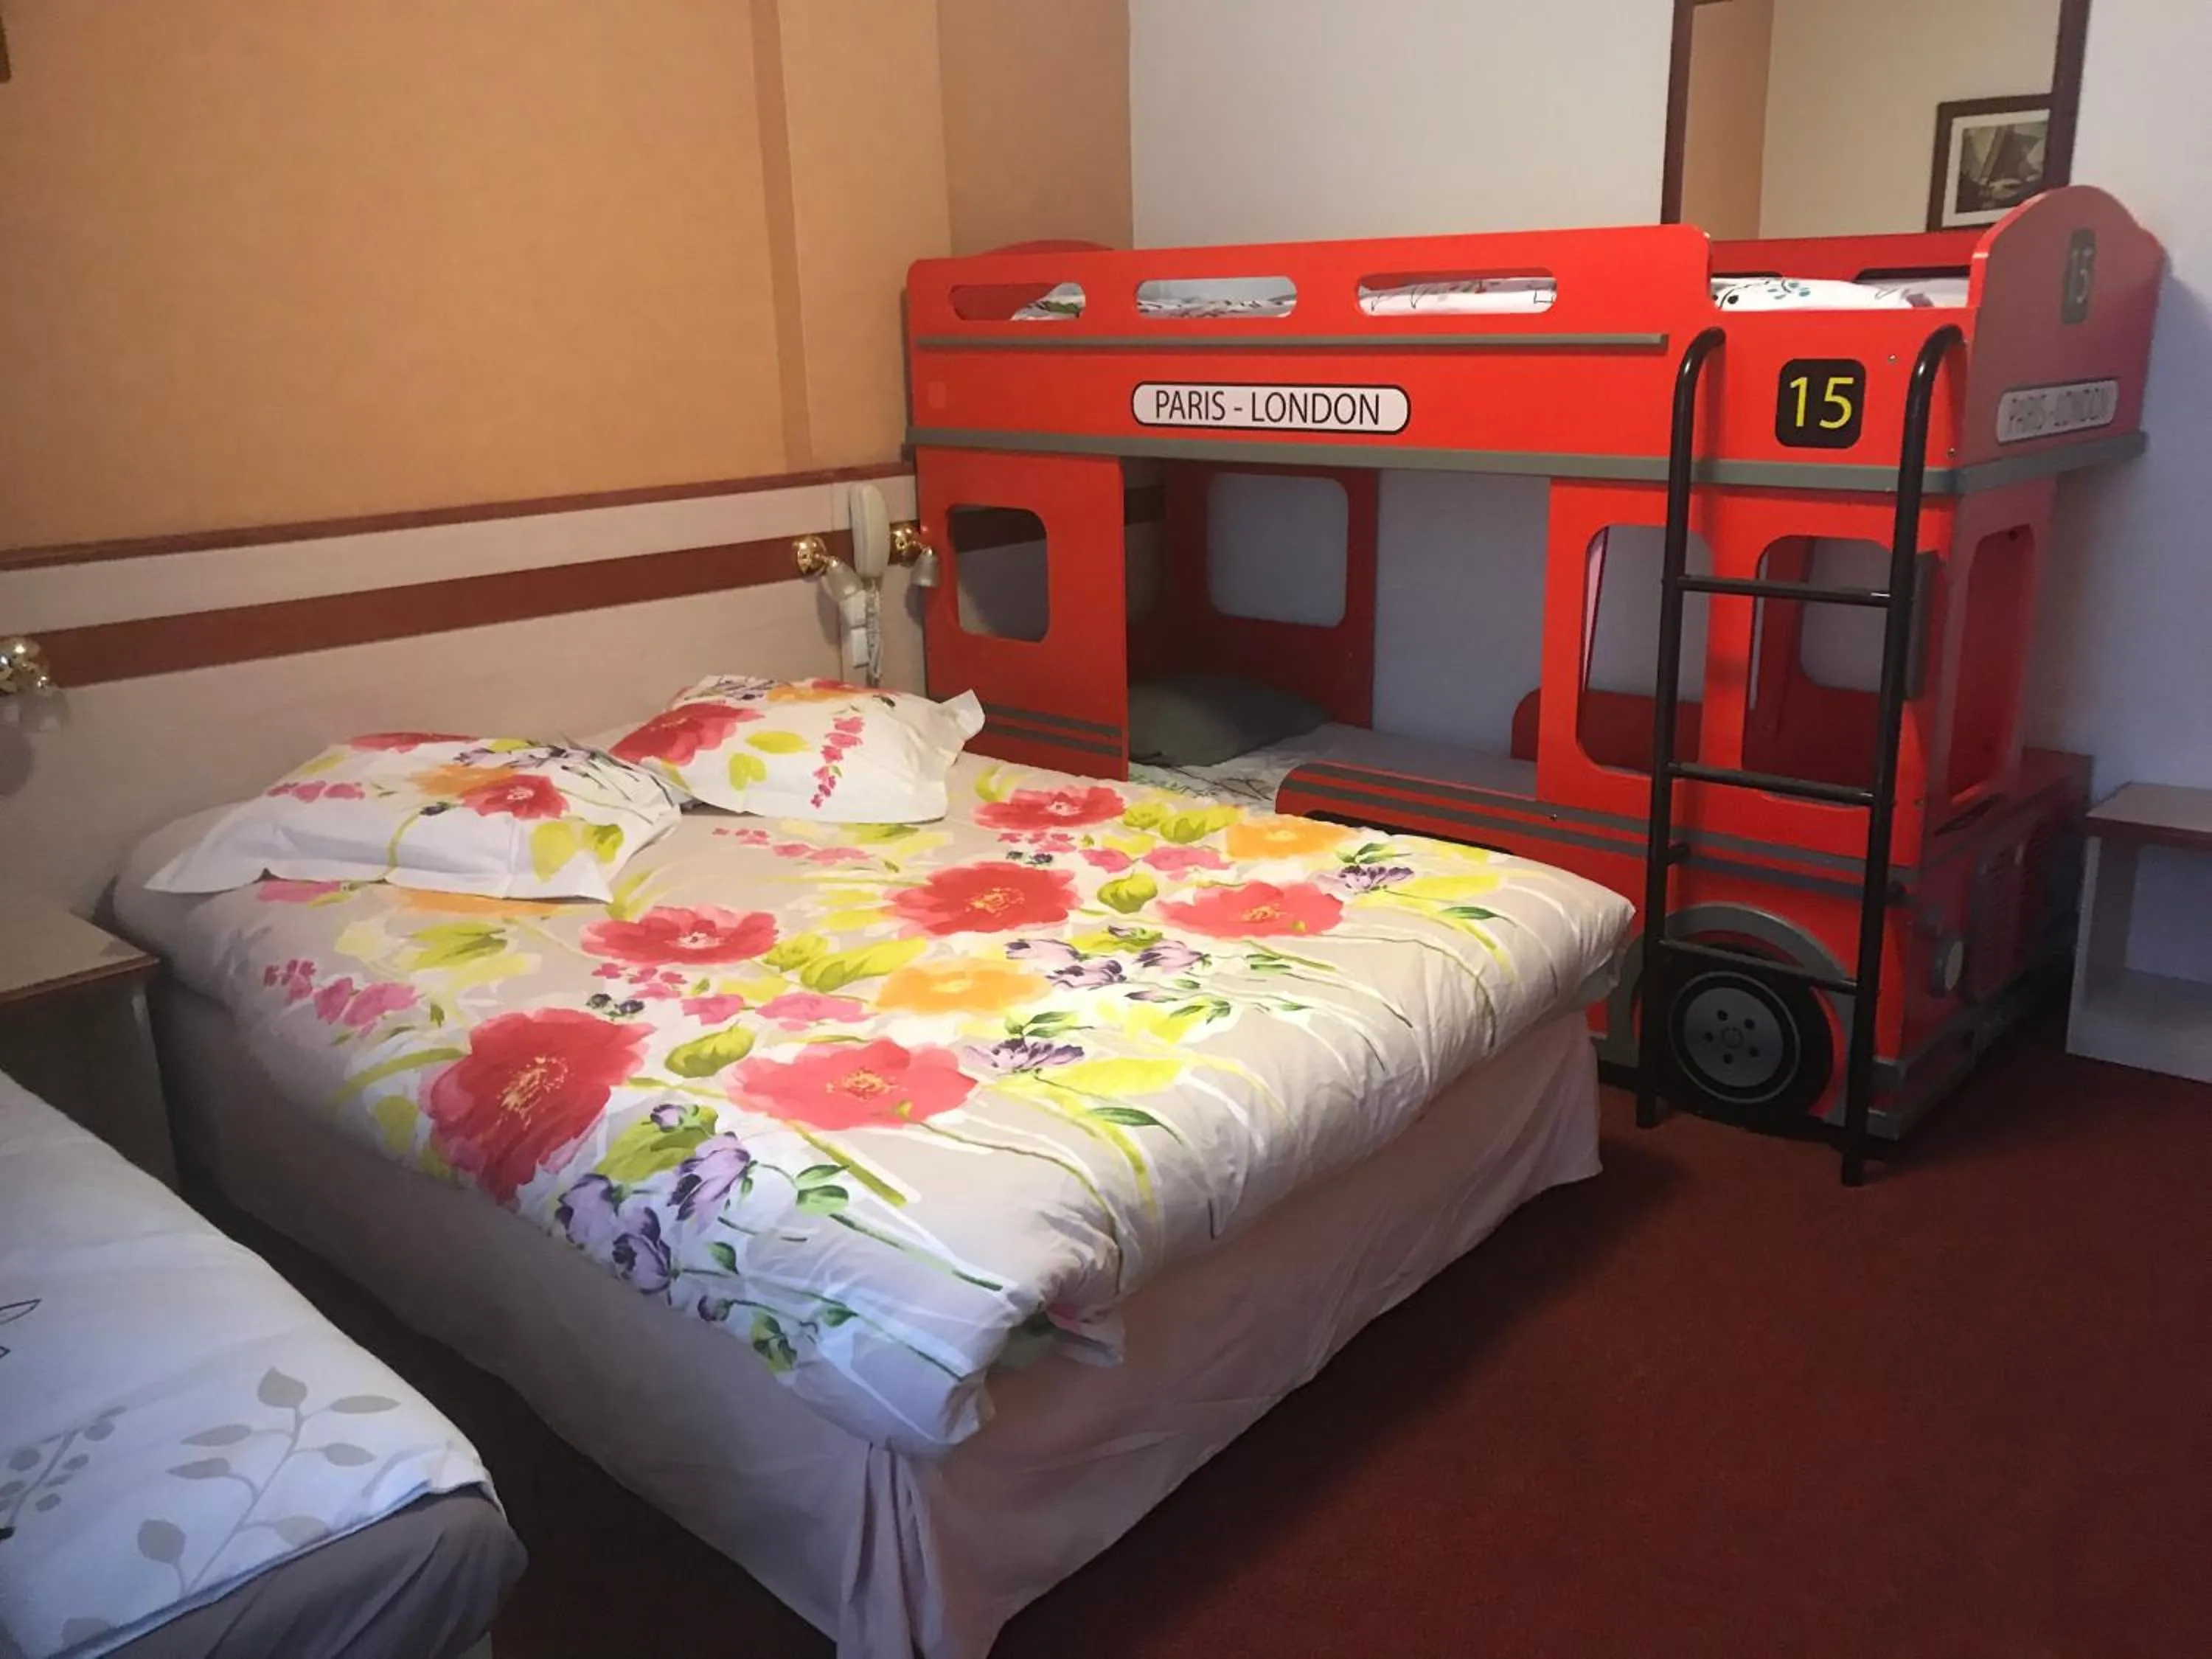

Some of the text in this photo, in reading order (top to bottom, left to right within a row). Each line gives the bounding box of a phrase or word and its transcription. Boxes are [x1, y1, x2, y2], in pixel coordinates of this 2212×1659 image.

[1155, 389, 1225, 420] PARIS
[1252, 392, 1380, 425] LONDON
[1790, 377, 1854, 428] 15
